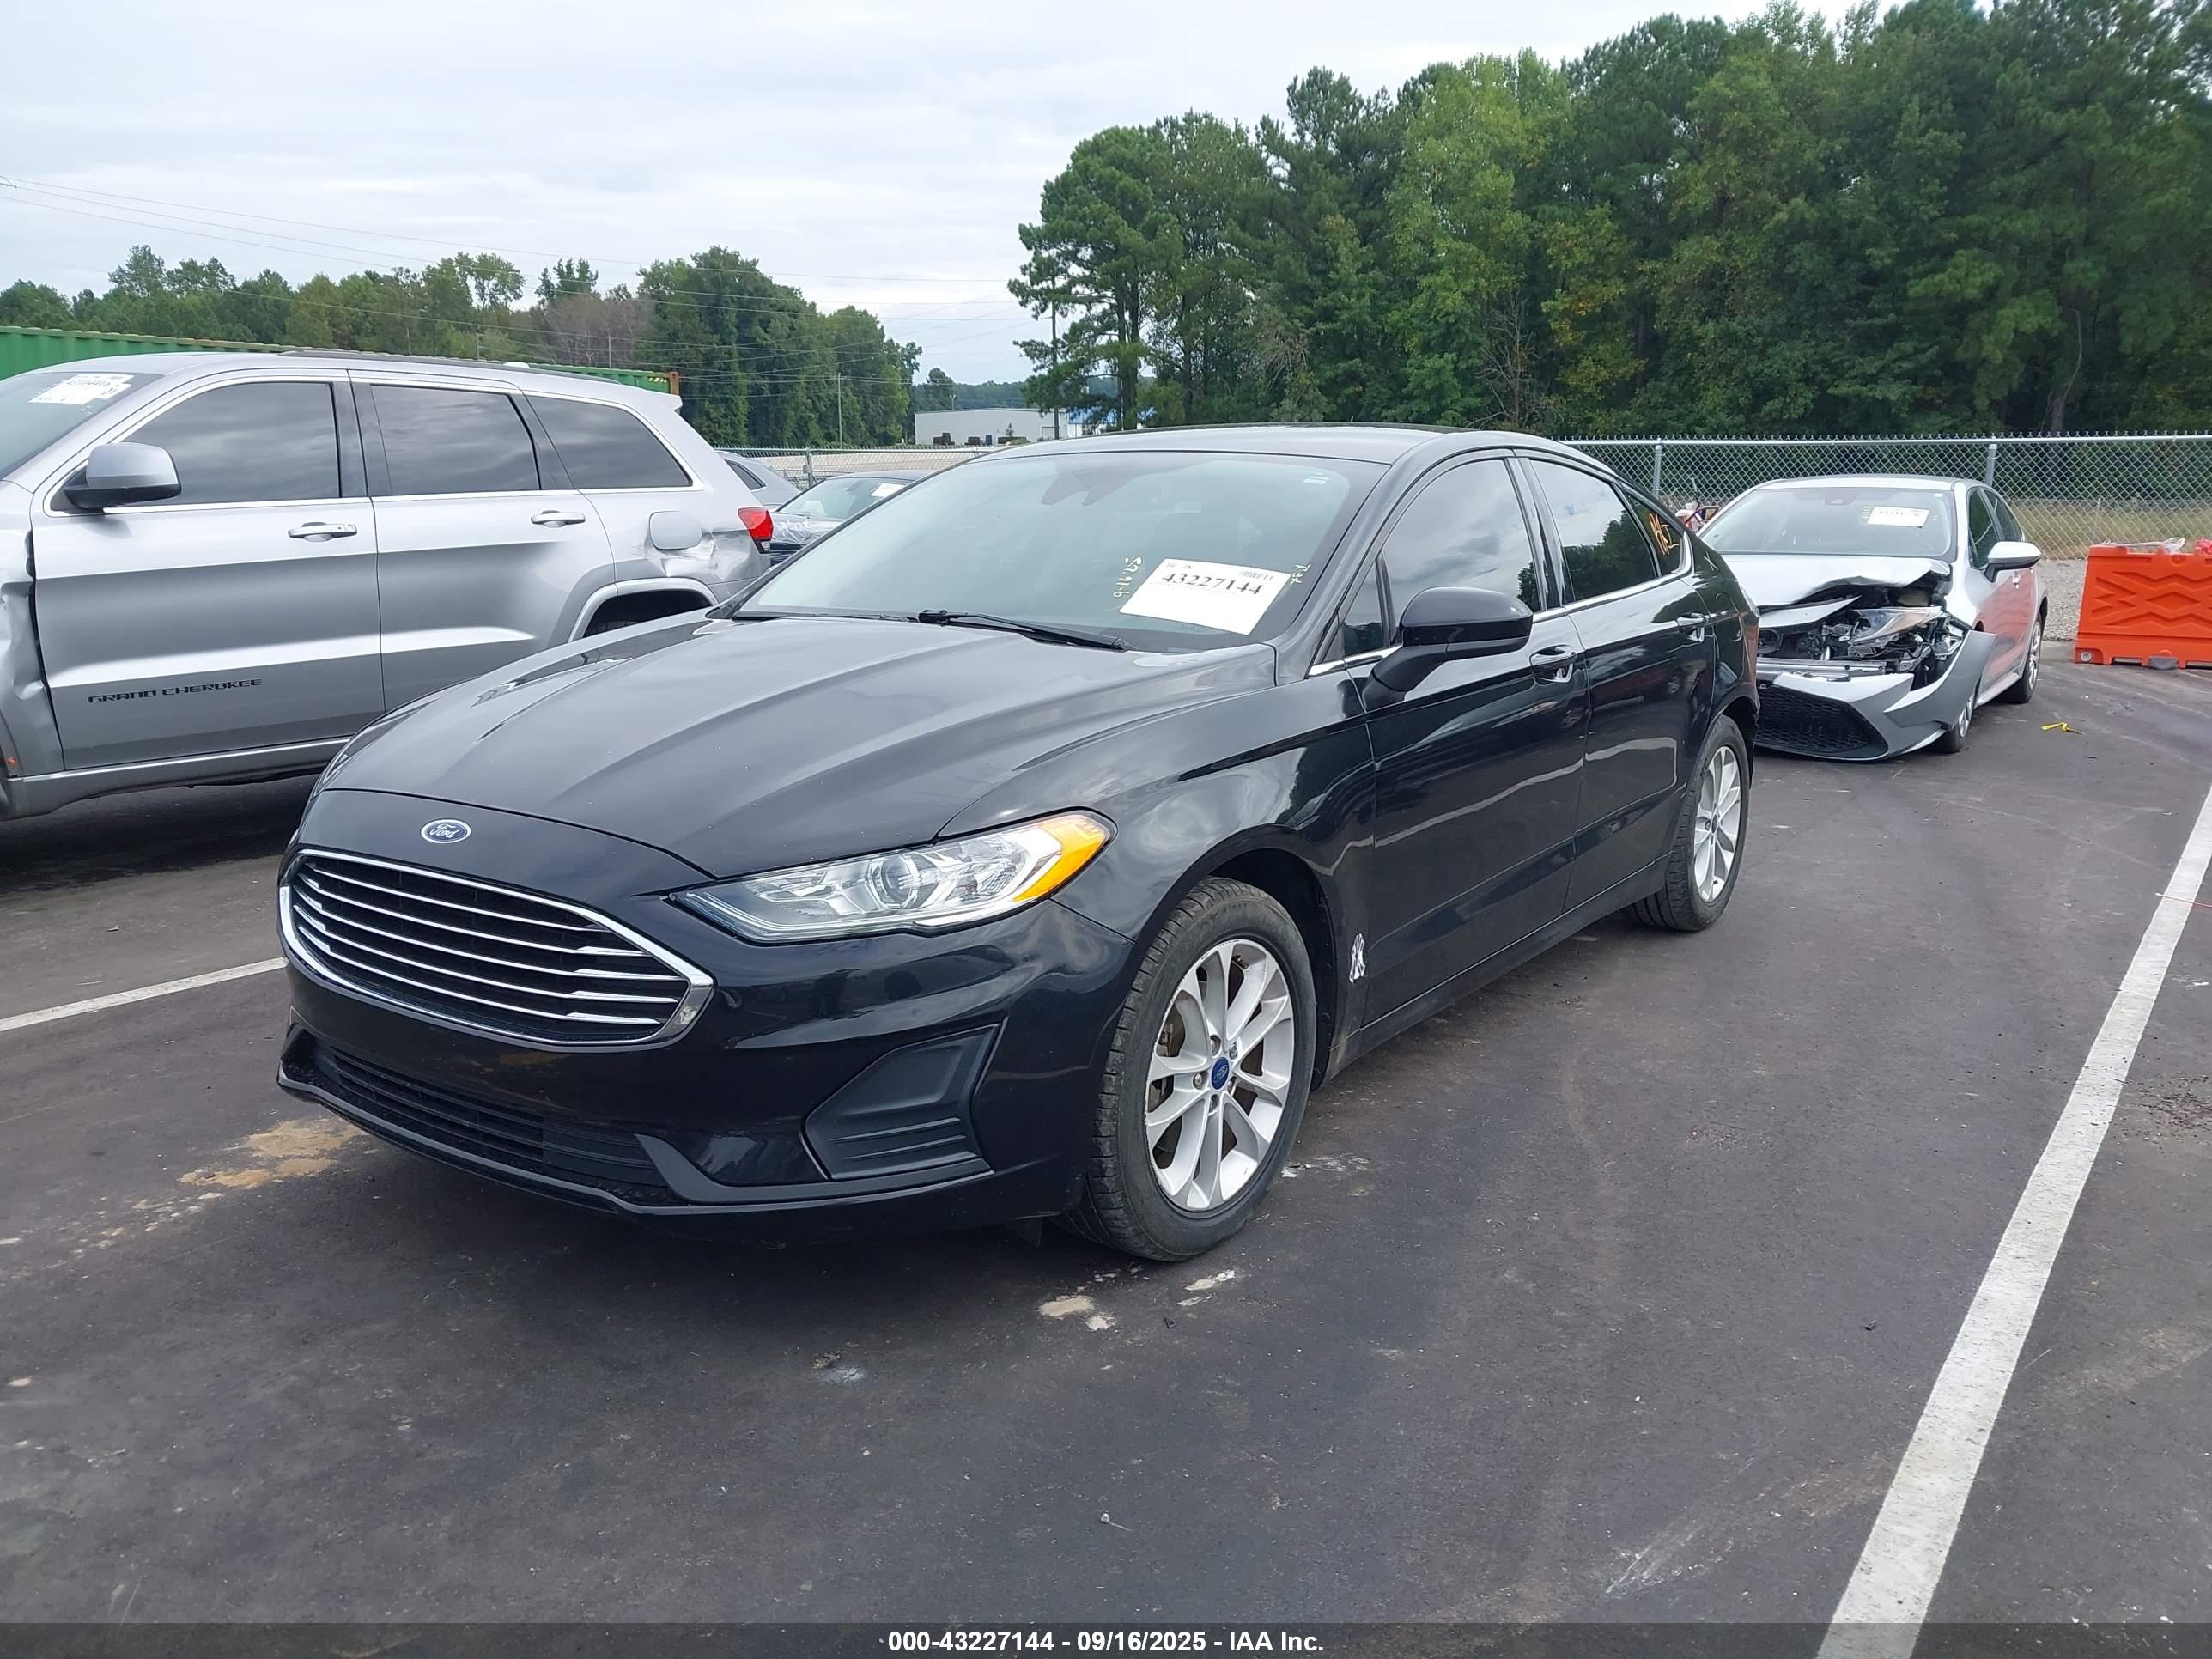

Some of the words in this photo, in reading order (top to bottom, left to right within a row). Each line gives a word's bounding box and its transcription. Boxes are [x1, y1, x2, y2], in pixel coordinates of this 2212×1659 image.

[1161, 572, 1263, 596] 43227144
[88, 690, 157, 703] GRAND
[161, 678, 262, 696] CHEROKEE
[429, 823, 459, 839] Ford
